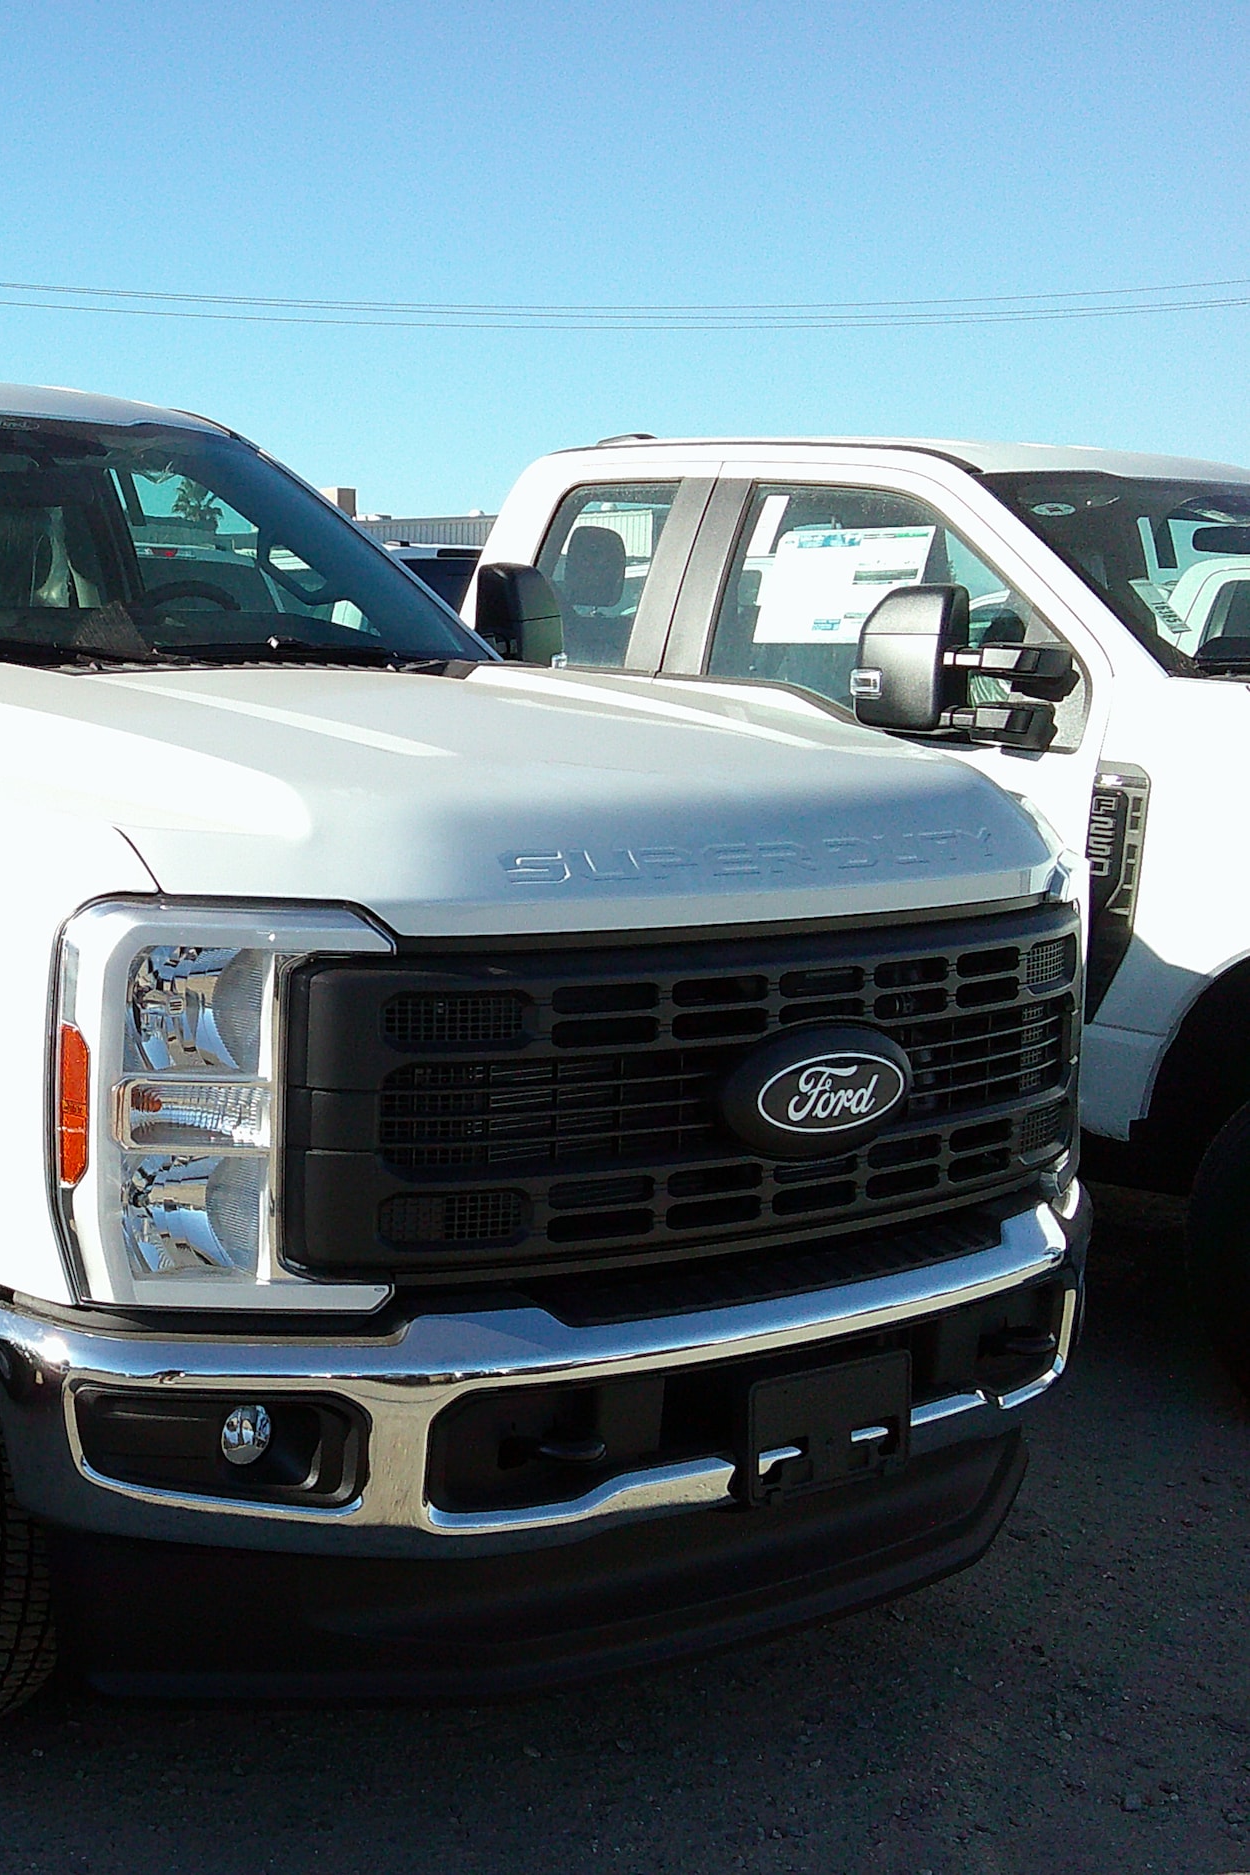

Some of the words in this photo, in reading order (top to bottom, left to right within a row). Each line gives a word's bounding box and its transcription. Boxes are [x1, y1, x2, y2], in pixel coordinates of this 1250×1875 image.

[498, 841, 818, 885] SUPER
[821, 826, 993, 871] DUTY
[1087, 796, 1117, 877] F250
[787, 1064, 880, 1122] Ford
